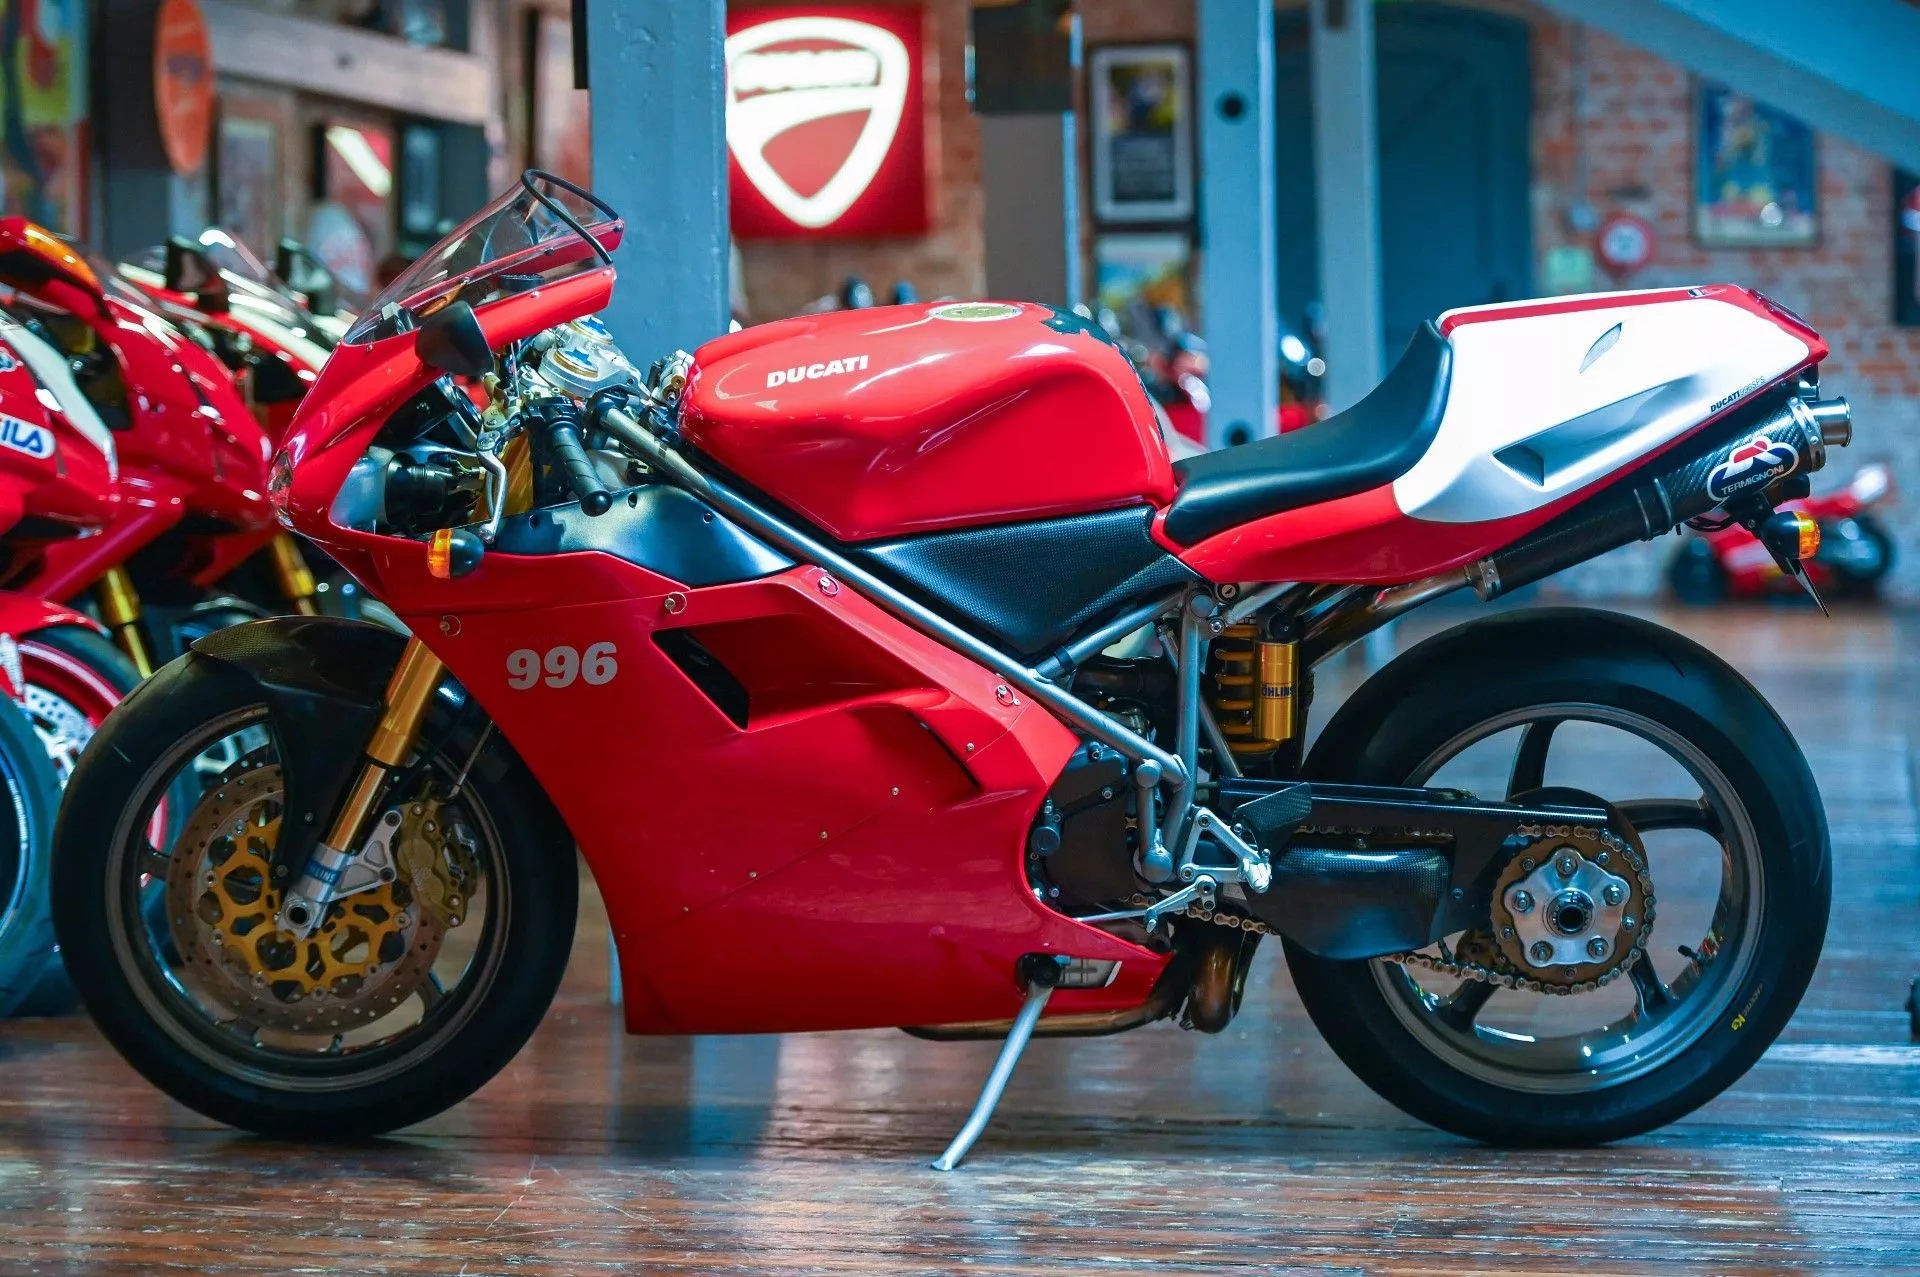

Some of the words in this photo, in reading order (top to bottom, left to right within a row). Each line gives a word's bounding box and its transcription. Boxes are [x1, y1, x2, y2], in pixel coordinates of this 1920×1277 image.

[766, 355, 869, 388] DUCATI
[1710, 391, 1740, 412] DUCATI
[0, 418, 43, 453] ILA
[1721, 464, 1784, 495] TERMIGNONI
[506, 641, 618, 690] 996
